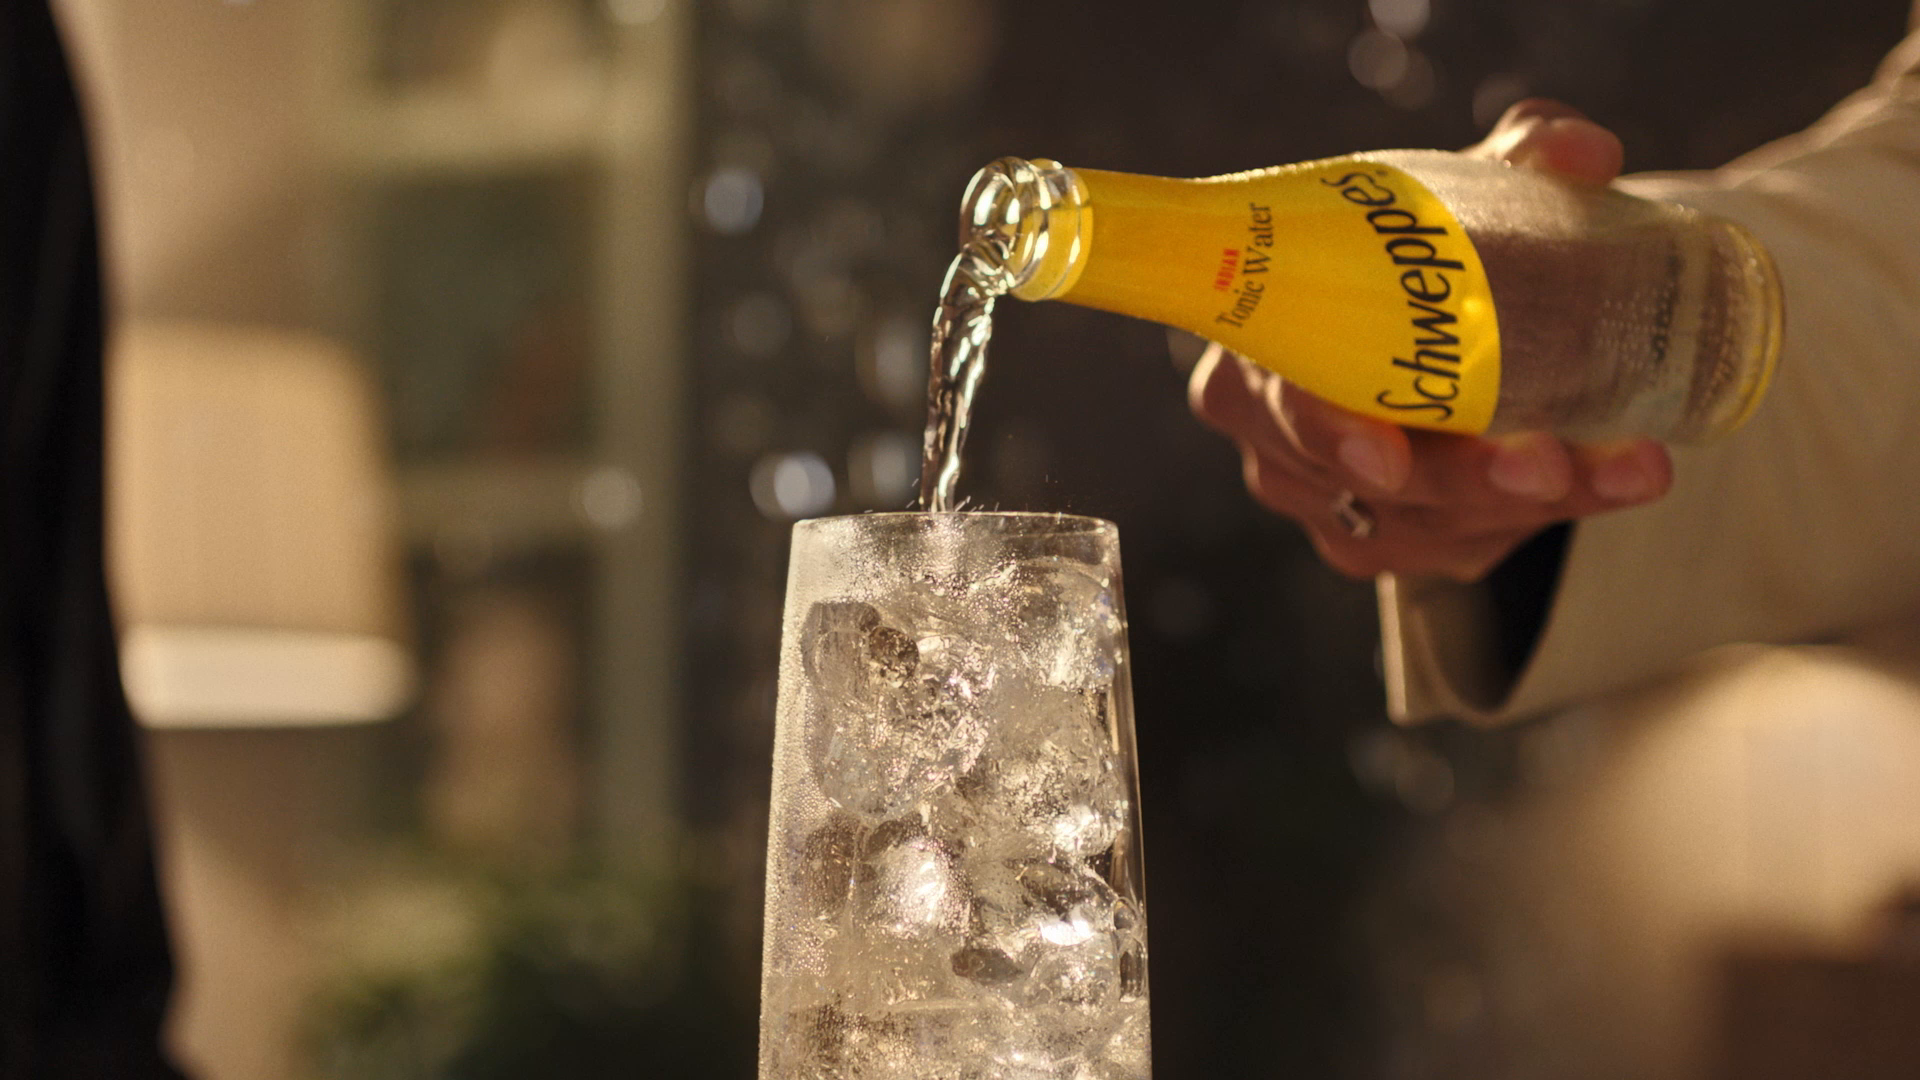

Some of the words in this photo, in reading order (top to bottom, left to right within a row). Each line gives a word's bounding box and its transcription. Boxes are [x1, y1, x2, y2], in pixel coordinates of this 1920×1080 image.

[1215, 281, 1265, 328] Tonic
[1242, 202, 1274, 275] Water
[1320, 171, 1466, 422] Schweppes
